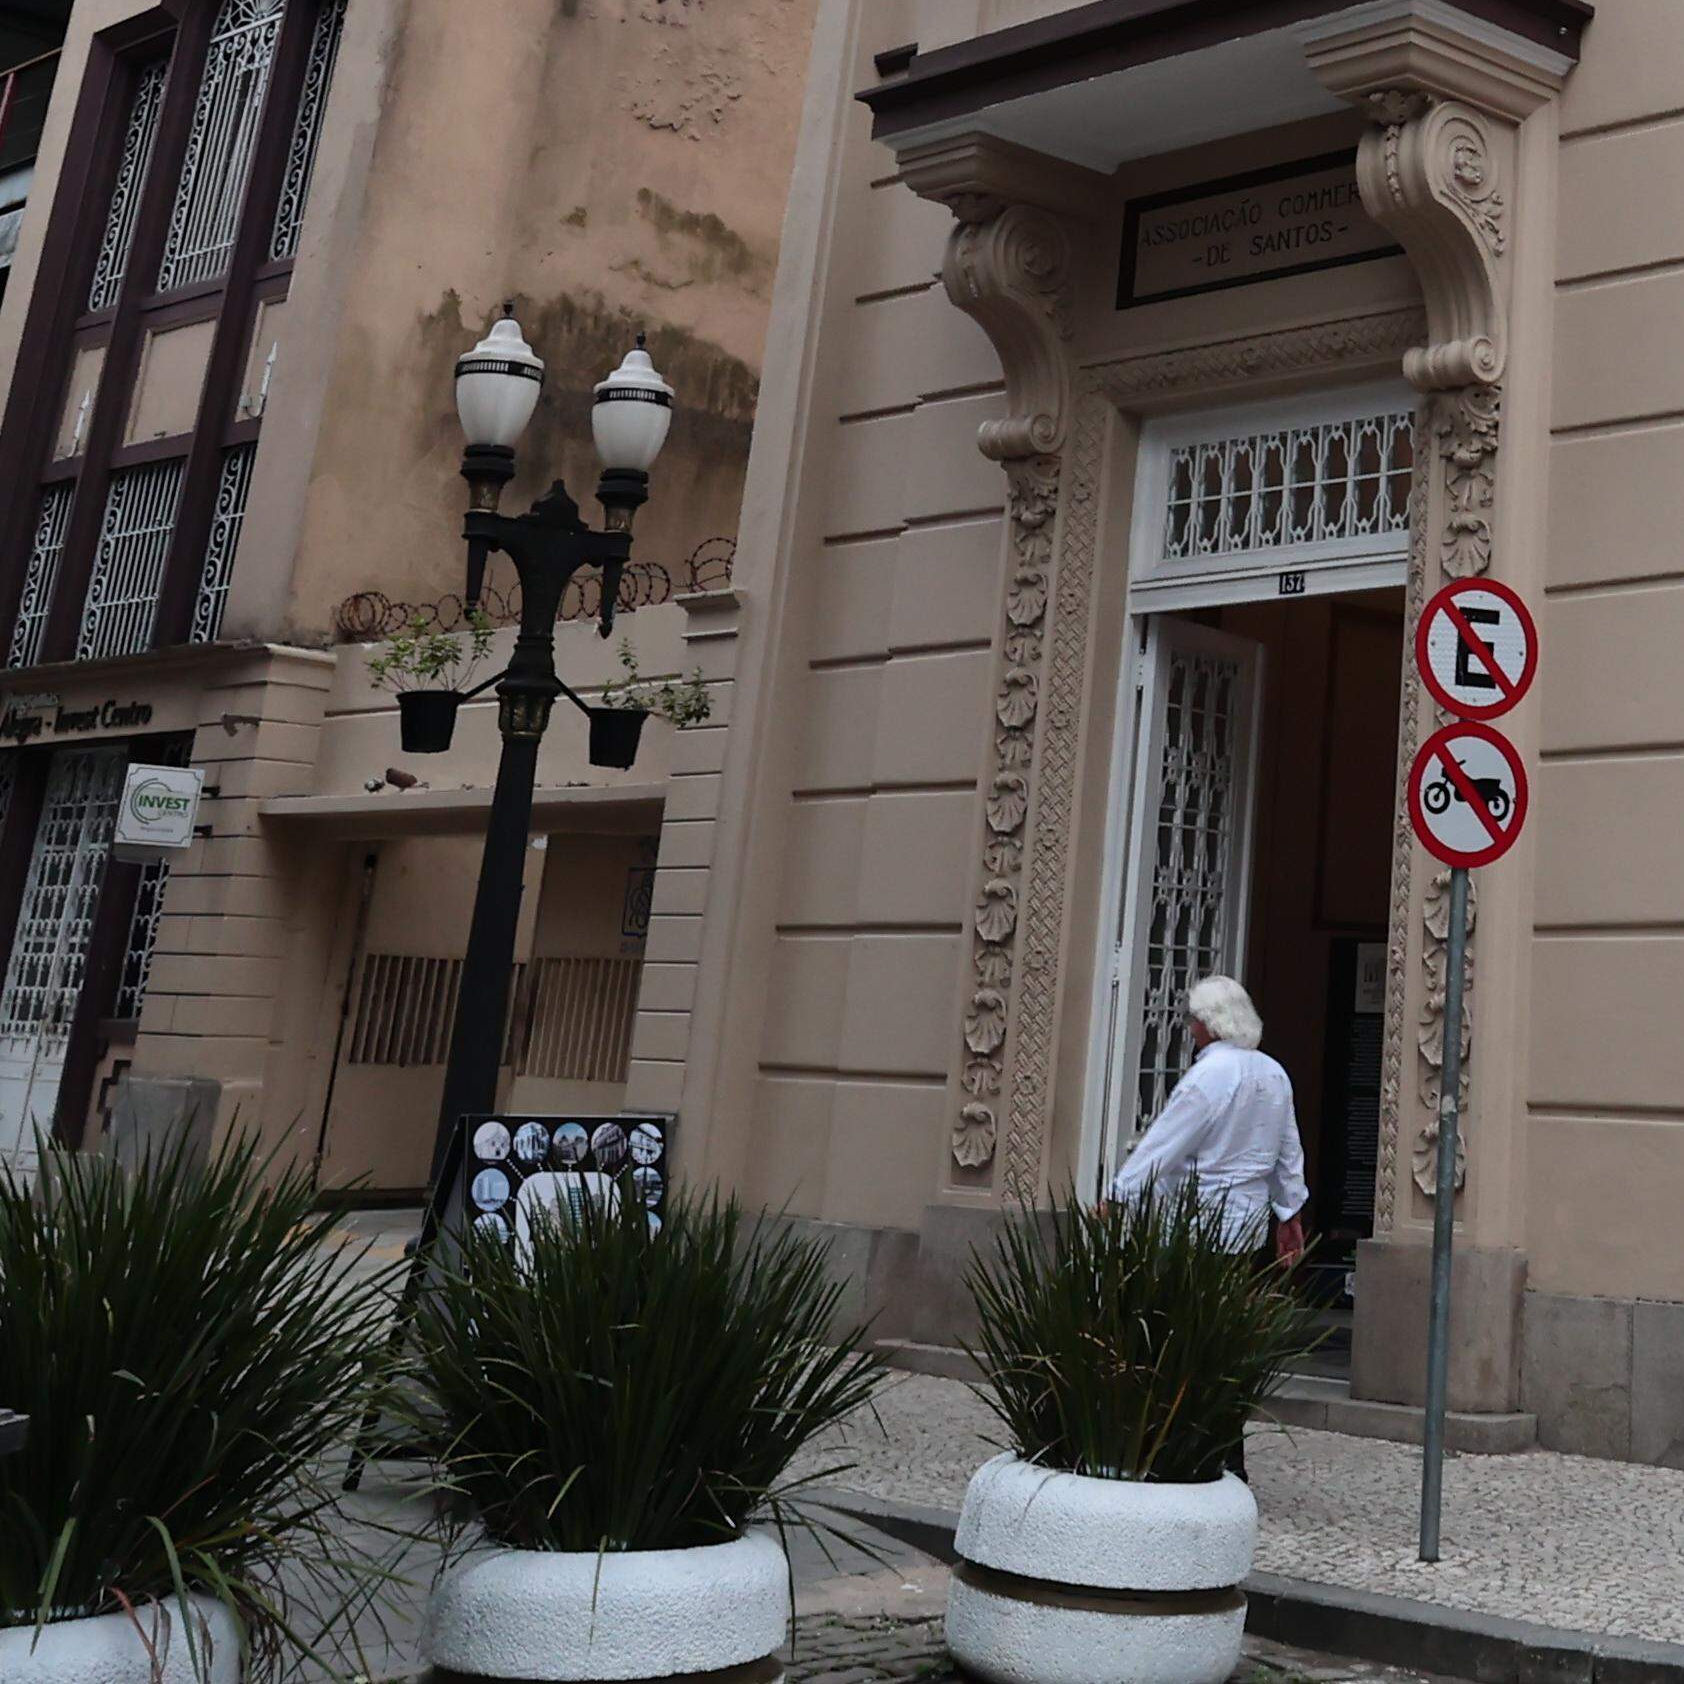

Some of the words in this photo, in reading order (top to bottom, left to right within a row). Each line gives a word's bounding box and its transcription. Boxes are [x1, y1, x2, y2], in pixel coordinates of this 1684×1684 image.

[1140, 197, 1263, 248] ASSOCIAÇÃO
[1281, 573, 1303, 593] 137
[1454, 606, 1501, 689] E
[101, 699, 153, 729] Centro
[138, 794, 191, 811] INVEST
